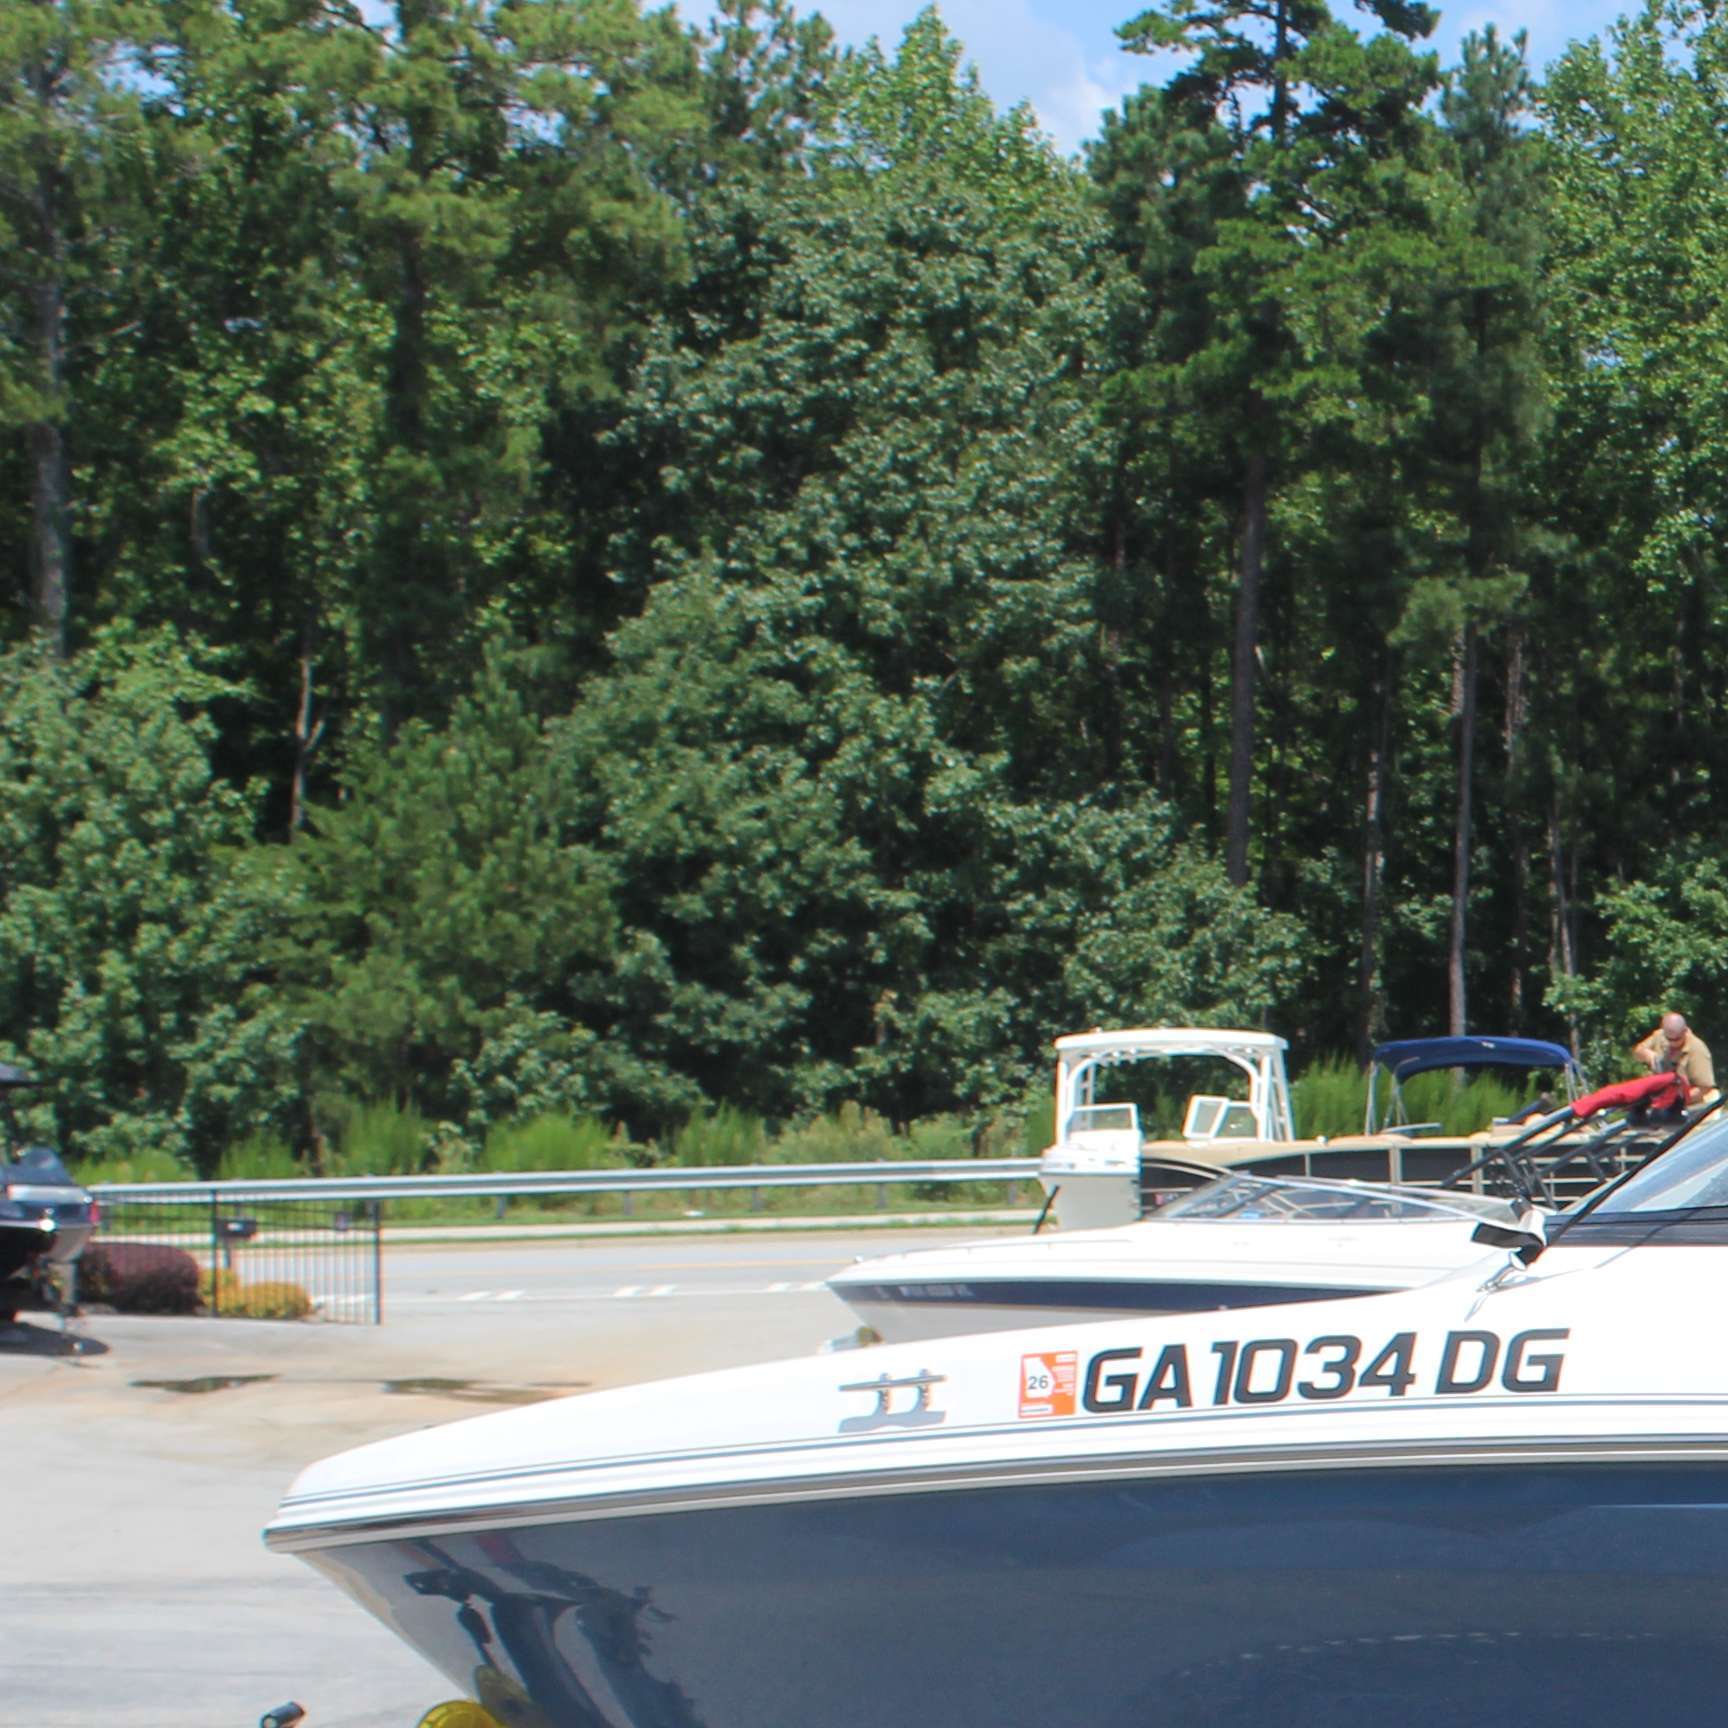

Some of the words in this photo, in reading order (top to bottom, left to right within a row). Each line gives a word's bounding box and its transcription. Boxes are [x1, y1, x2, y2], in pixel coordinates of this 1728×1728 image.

[1027, 1375, 1049, 1391] 26
[1081, 1344, 1193, 1413] GA
[1210, 1330, 1418, 1407] 1034
[1434, 1326, 1571, 1394] DG
